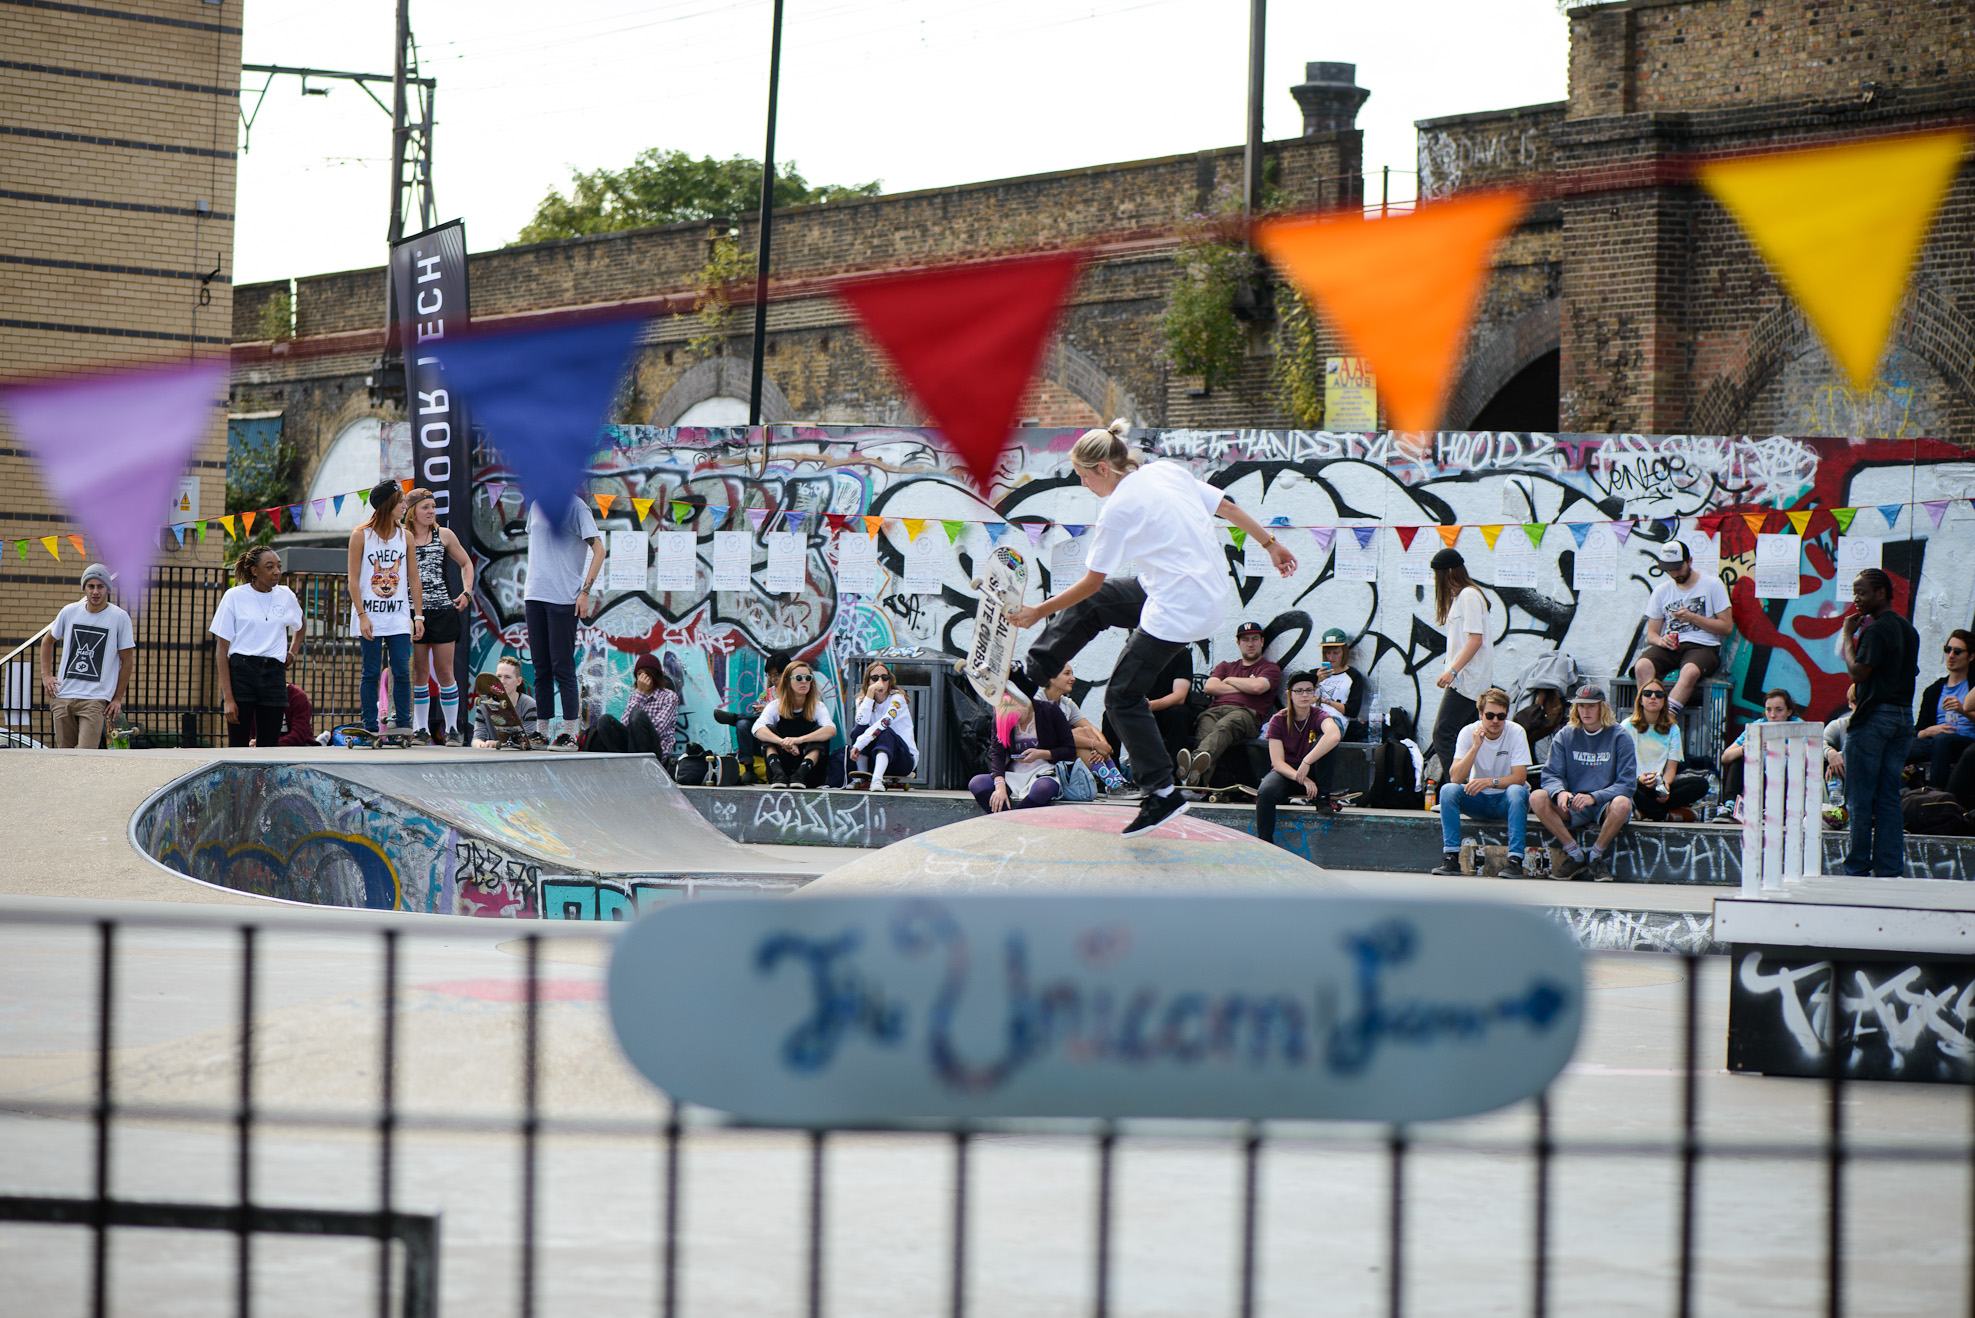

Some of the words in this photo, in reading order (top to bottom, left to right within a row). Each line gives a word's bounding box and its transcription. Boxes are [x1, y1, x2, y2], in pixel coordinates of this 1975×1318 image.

[367, 549, 406, 566] CHECK
[363, 600, 404, 613] MEOWT
[1243, 622, 1252, 631] W
[662, 626, 736, 656] SNAKE
